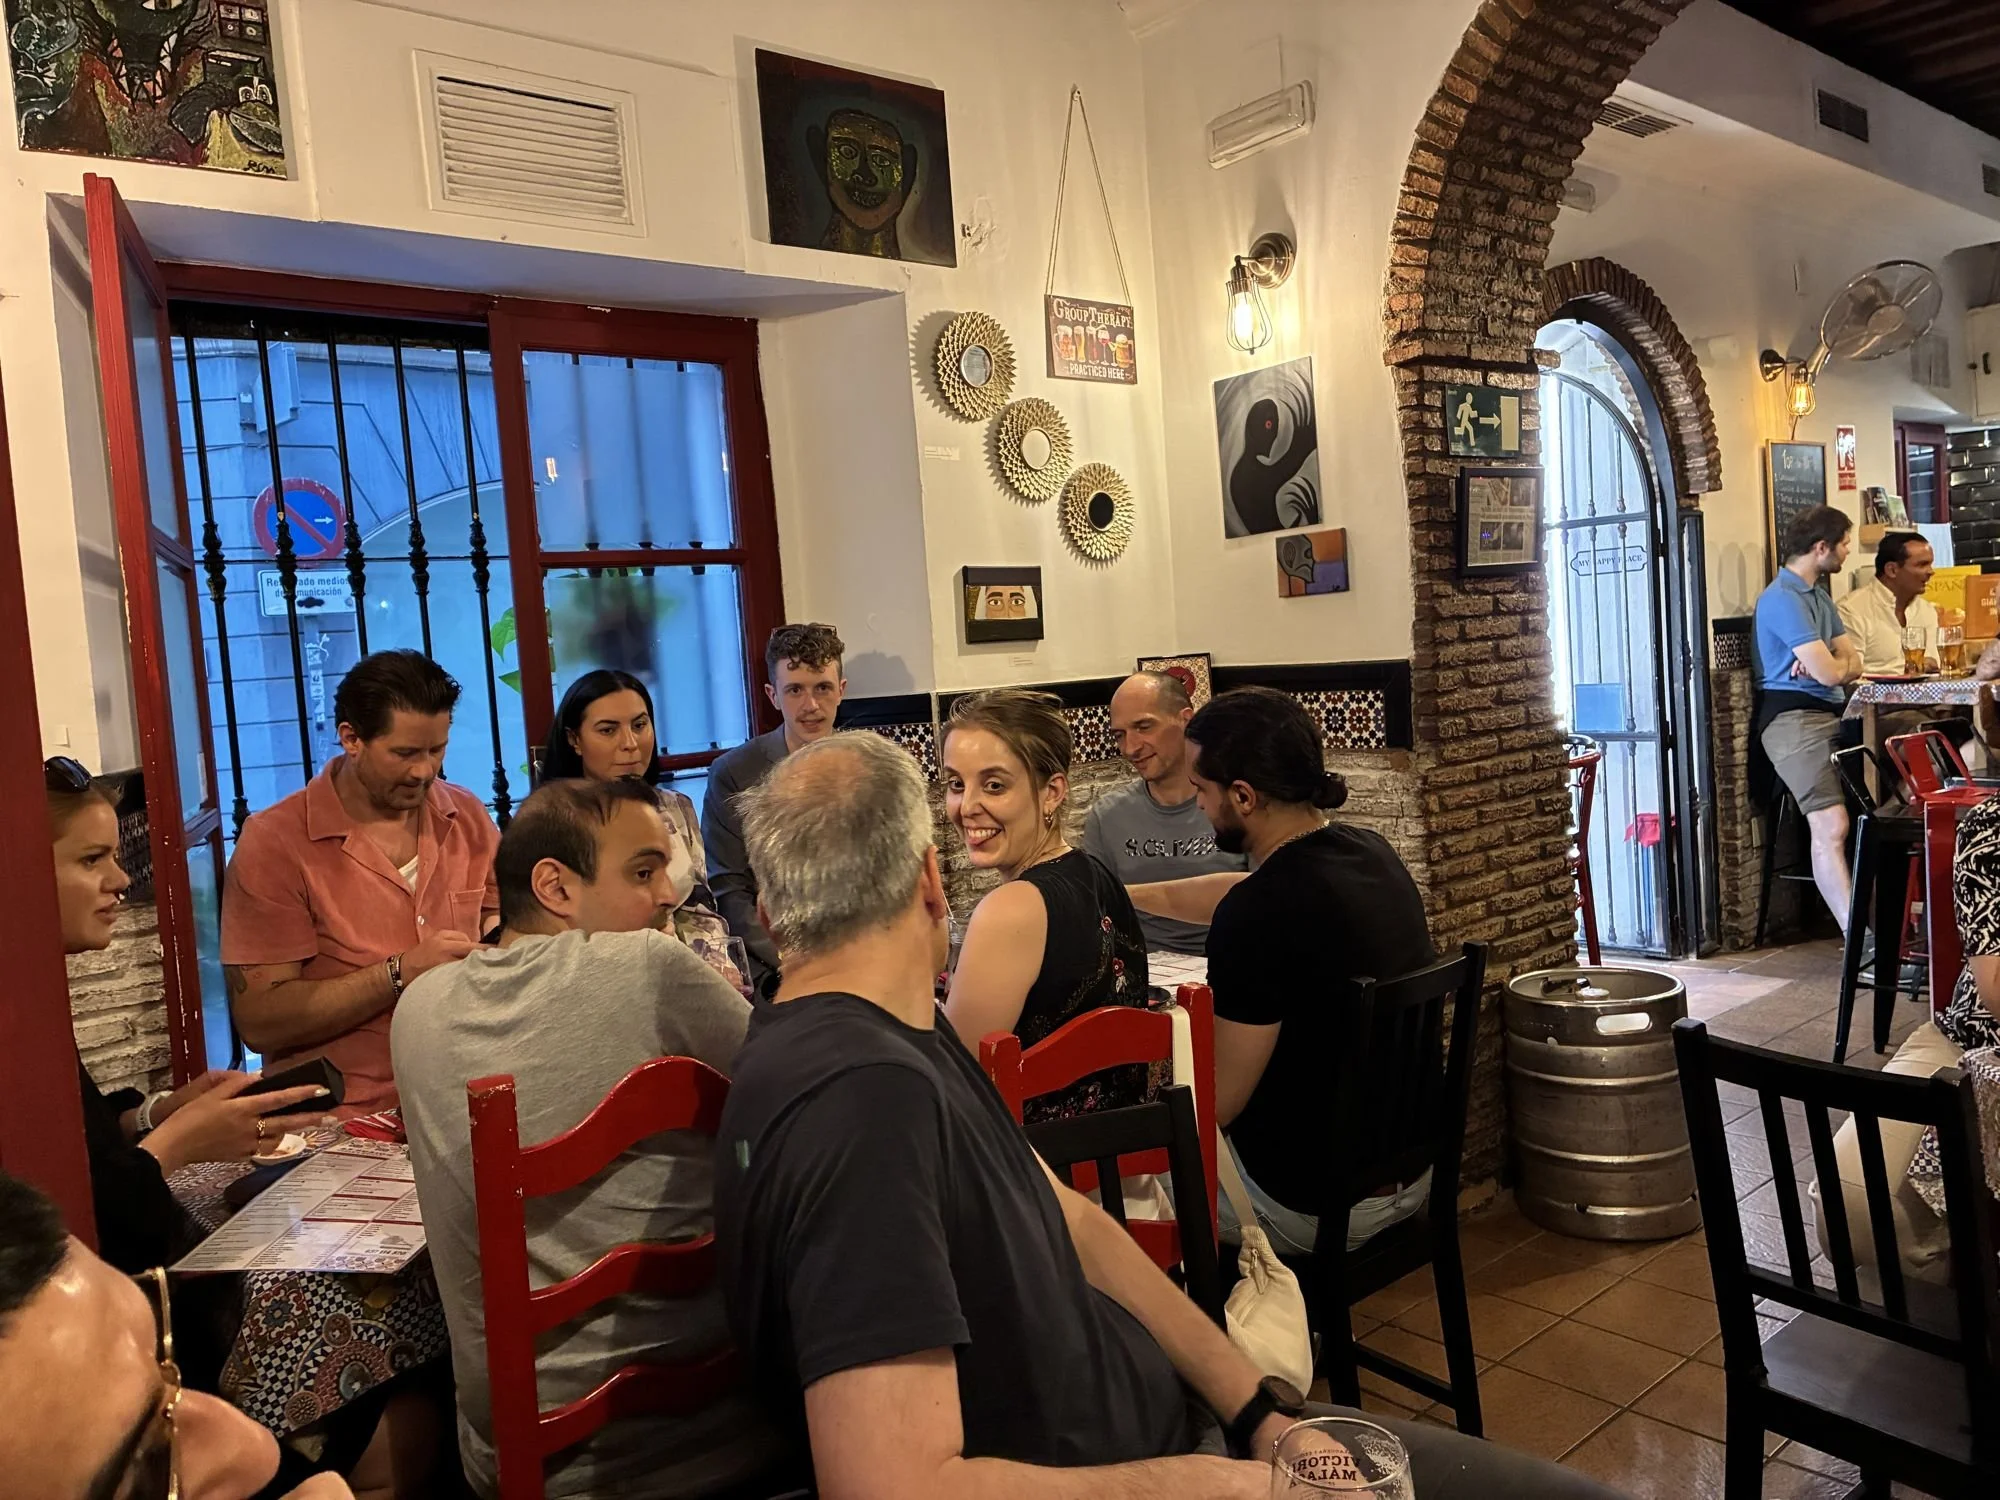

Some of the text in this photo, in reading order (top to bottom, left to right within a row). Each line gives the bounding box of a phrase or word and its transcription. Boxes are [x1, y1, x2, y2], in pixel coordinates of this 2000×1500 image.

[1053, 298, 1132, 328] GROUP THERAPY
[1069, 363, 1125, 380] PRACTICED HERE
[1578, 559, 1590, 567] MY
[266, 577, 315, 587] Reado
[296, 588, 342, 597] municación
